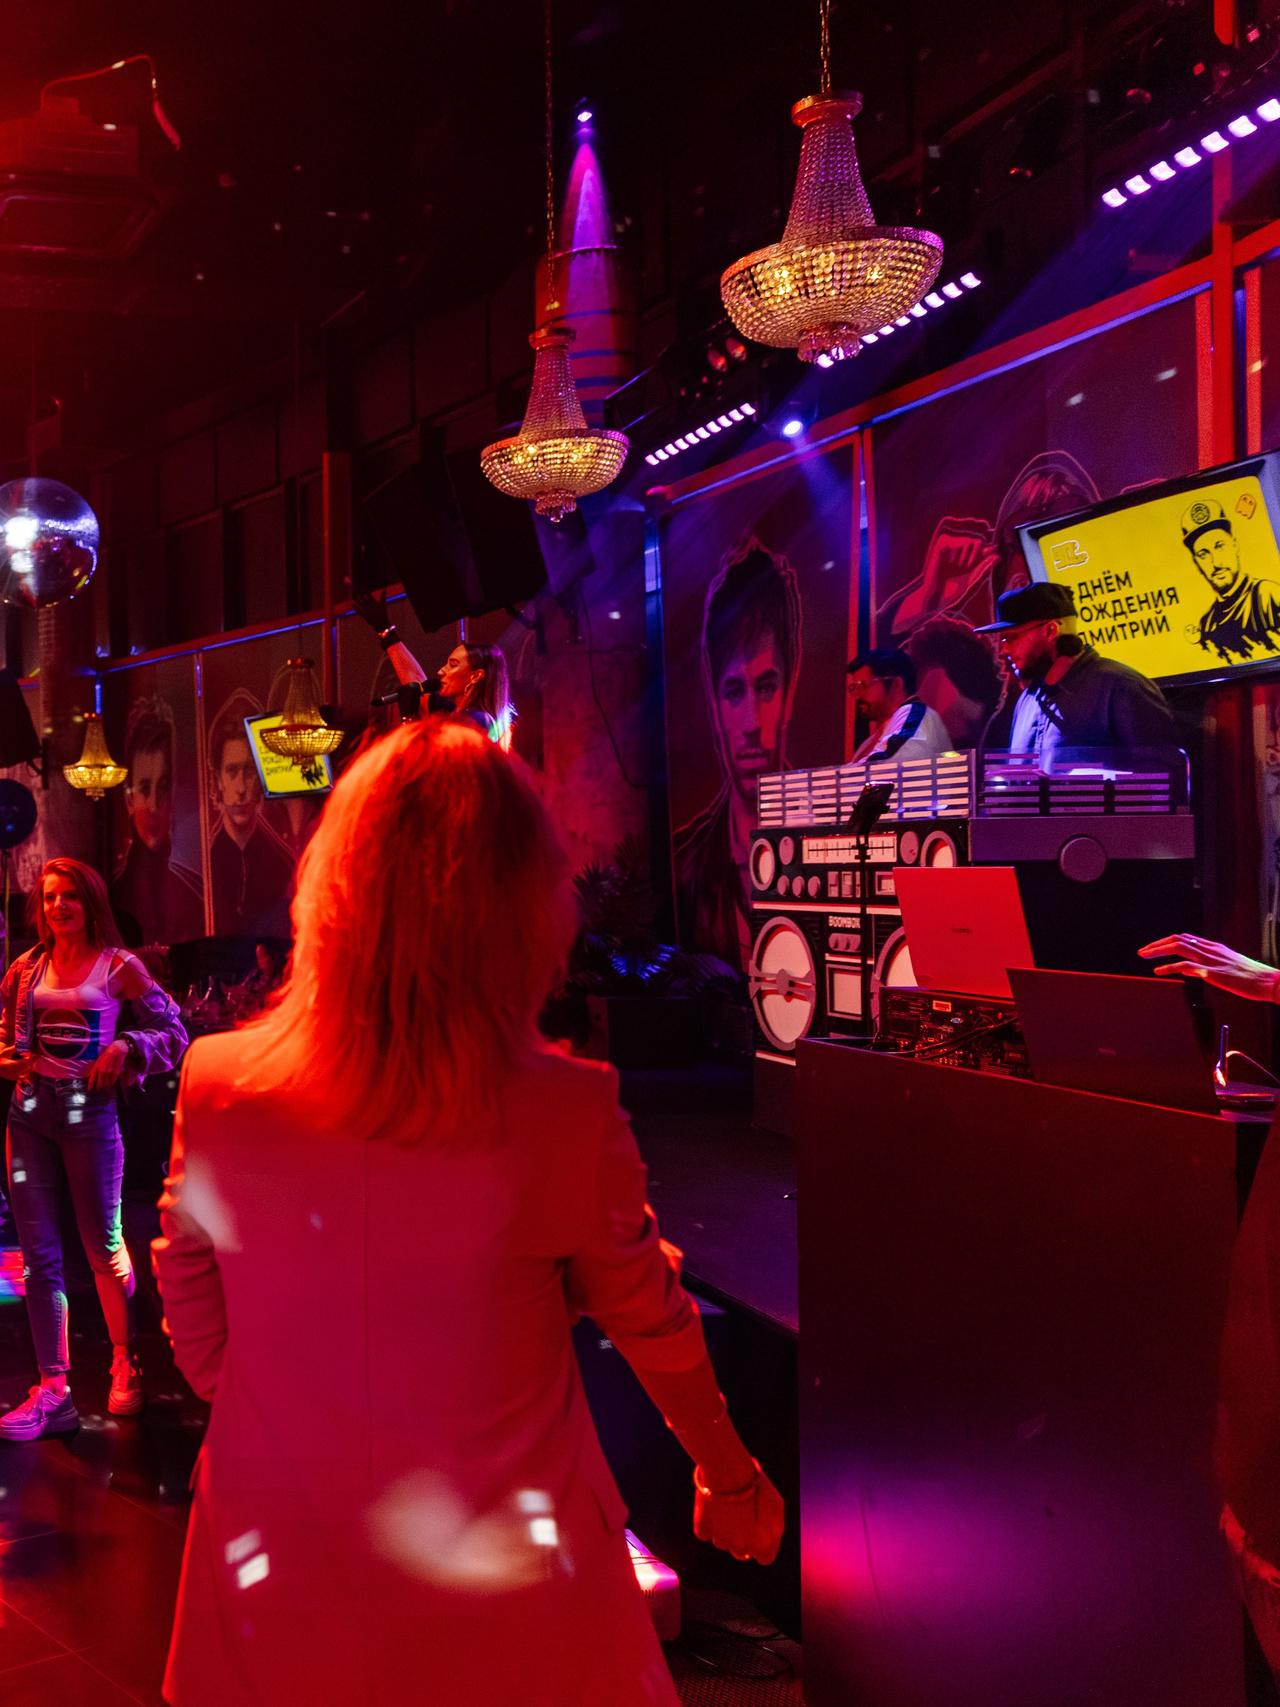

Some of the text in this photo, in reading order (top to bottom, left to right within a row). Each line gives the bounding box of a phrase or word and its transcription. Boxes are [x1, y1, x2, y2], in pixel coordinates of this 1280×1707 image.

[1077, 569, 1133, 604] ДНЁМ
[1079, 586, 1180, 623] ОЖДЕНИЯ
[828, 915, 861, 929] BOOMBOX
[40, 1027, 86, 1039] PEPSI
